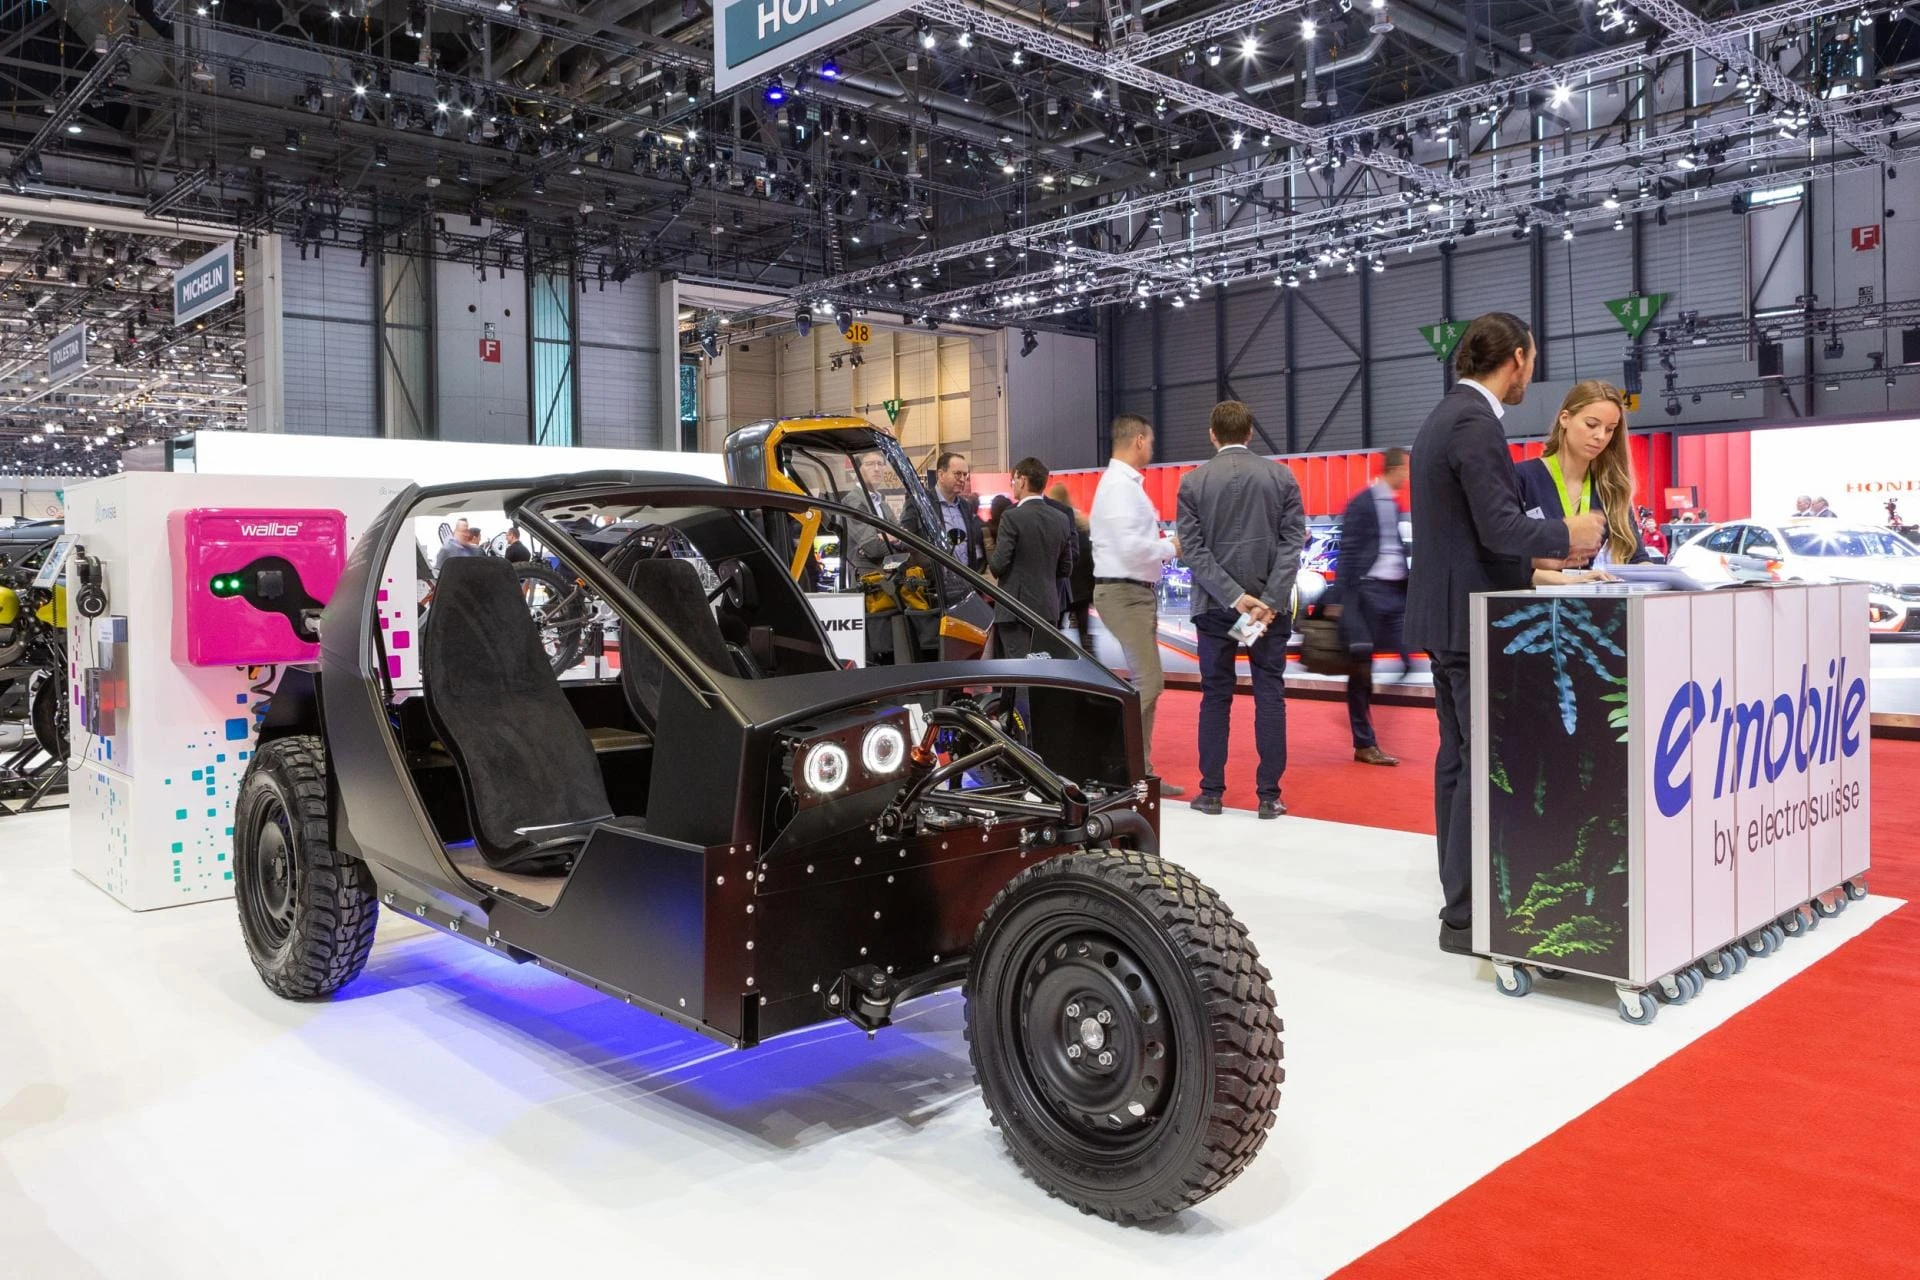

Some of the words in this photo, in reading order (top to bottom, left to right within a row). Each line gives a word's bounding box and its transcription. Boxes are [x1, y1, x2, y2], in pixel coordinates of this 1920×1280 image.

[1859, 227, 1874, 246] F
[182, 265, 223, 304] MICHELIN
[486, 340, 497, 357] F
[1714, 819, 1740, 872] by
[1747, 778, 1860, 853] electrosuisse
